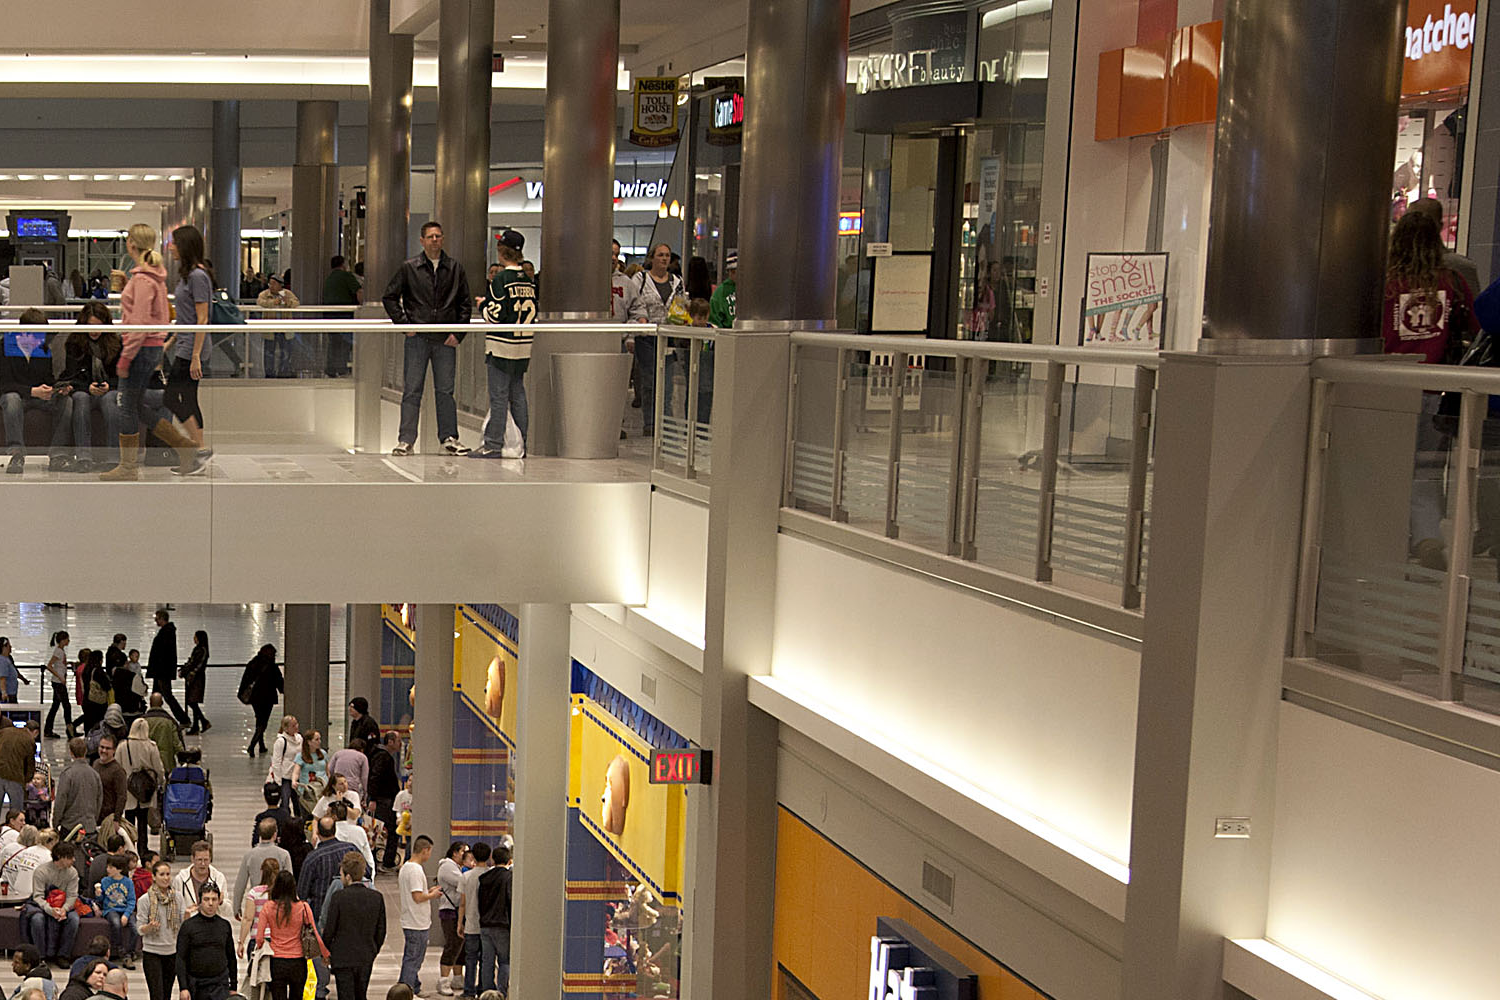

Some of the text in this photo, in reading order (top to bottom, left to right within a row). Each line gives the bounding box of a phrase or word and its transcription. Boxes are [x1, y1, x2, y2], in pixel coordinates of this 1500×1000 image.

[920, 63, 966, 83] bauty
[641, 104, 671, 114] HOUSE
[645, 96, 668, 105] TOLL
[1089, 263, 1118, 279] stop
[1090, 261, 1155, 298] smell
[1092, 295, 1115, 306] THE
[487, 301, 502, 319] 22
[655, 753, 696, 781] EXIT
